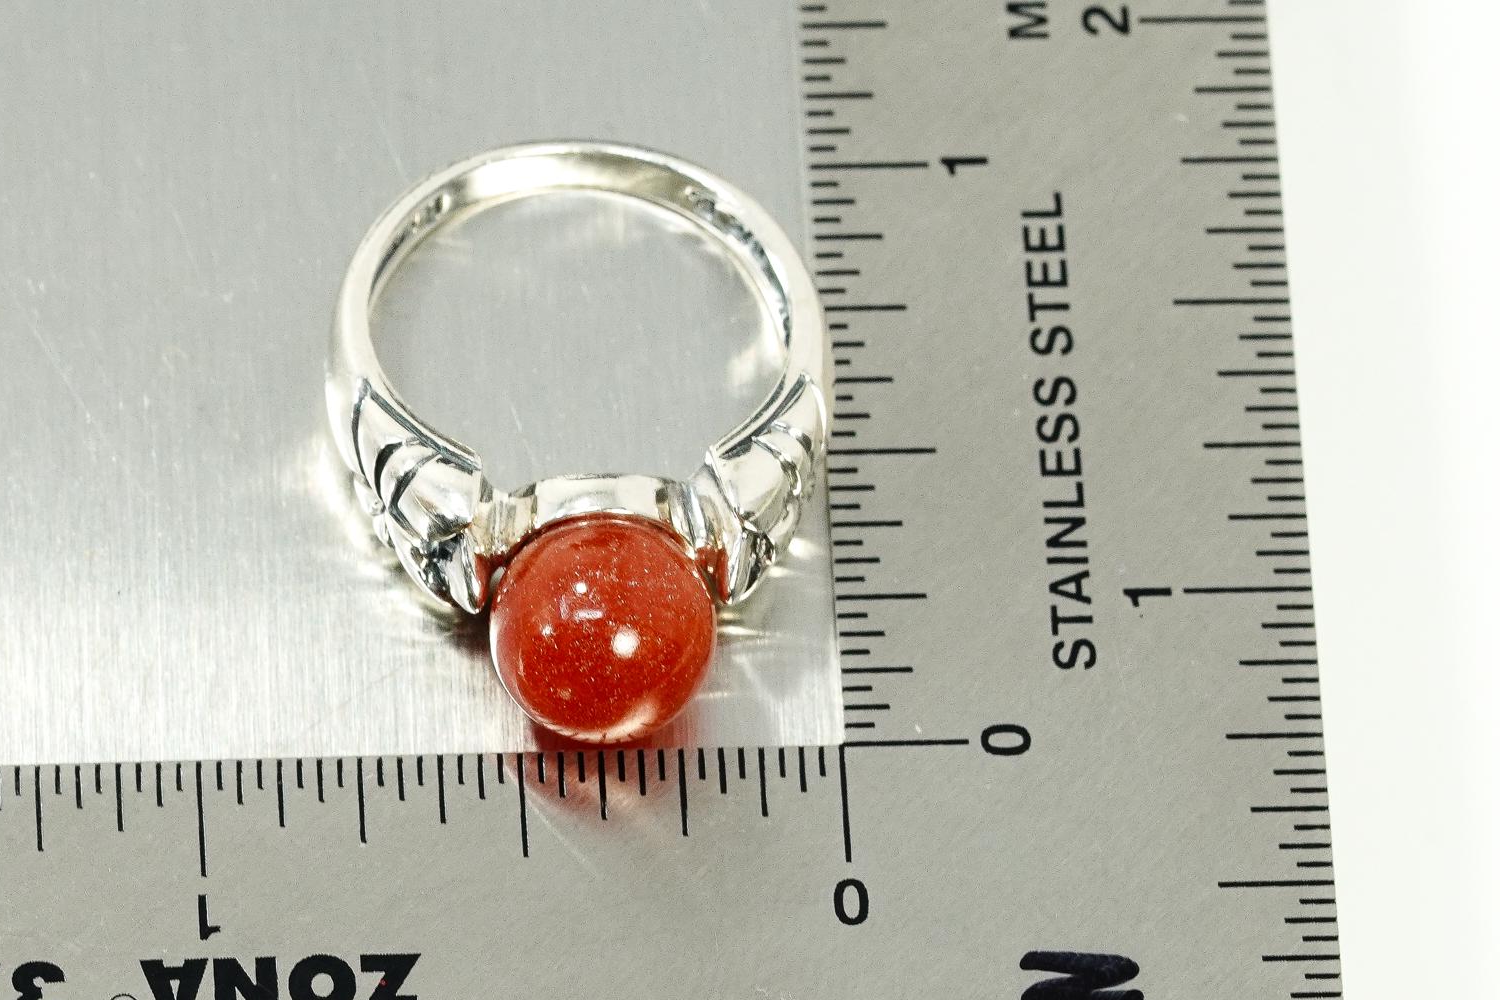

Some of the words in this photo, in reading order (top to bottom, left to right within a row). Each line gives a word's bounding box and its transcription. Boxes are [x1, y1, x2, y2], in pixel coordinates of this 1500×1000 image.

[1080, 5, 1130, 36] 2
[939, 155, 990, 176] 1
[1021, 192, 1074, 357] STEEL
[1033, 376, 1097, 671] STAINLESS
[1122, 586, 1173, 608] 1
[980, 722, 1033, 757] 0
[197, 894, 221, 941] 1
[833, 877, 870, 926] 0
